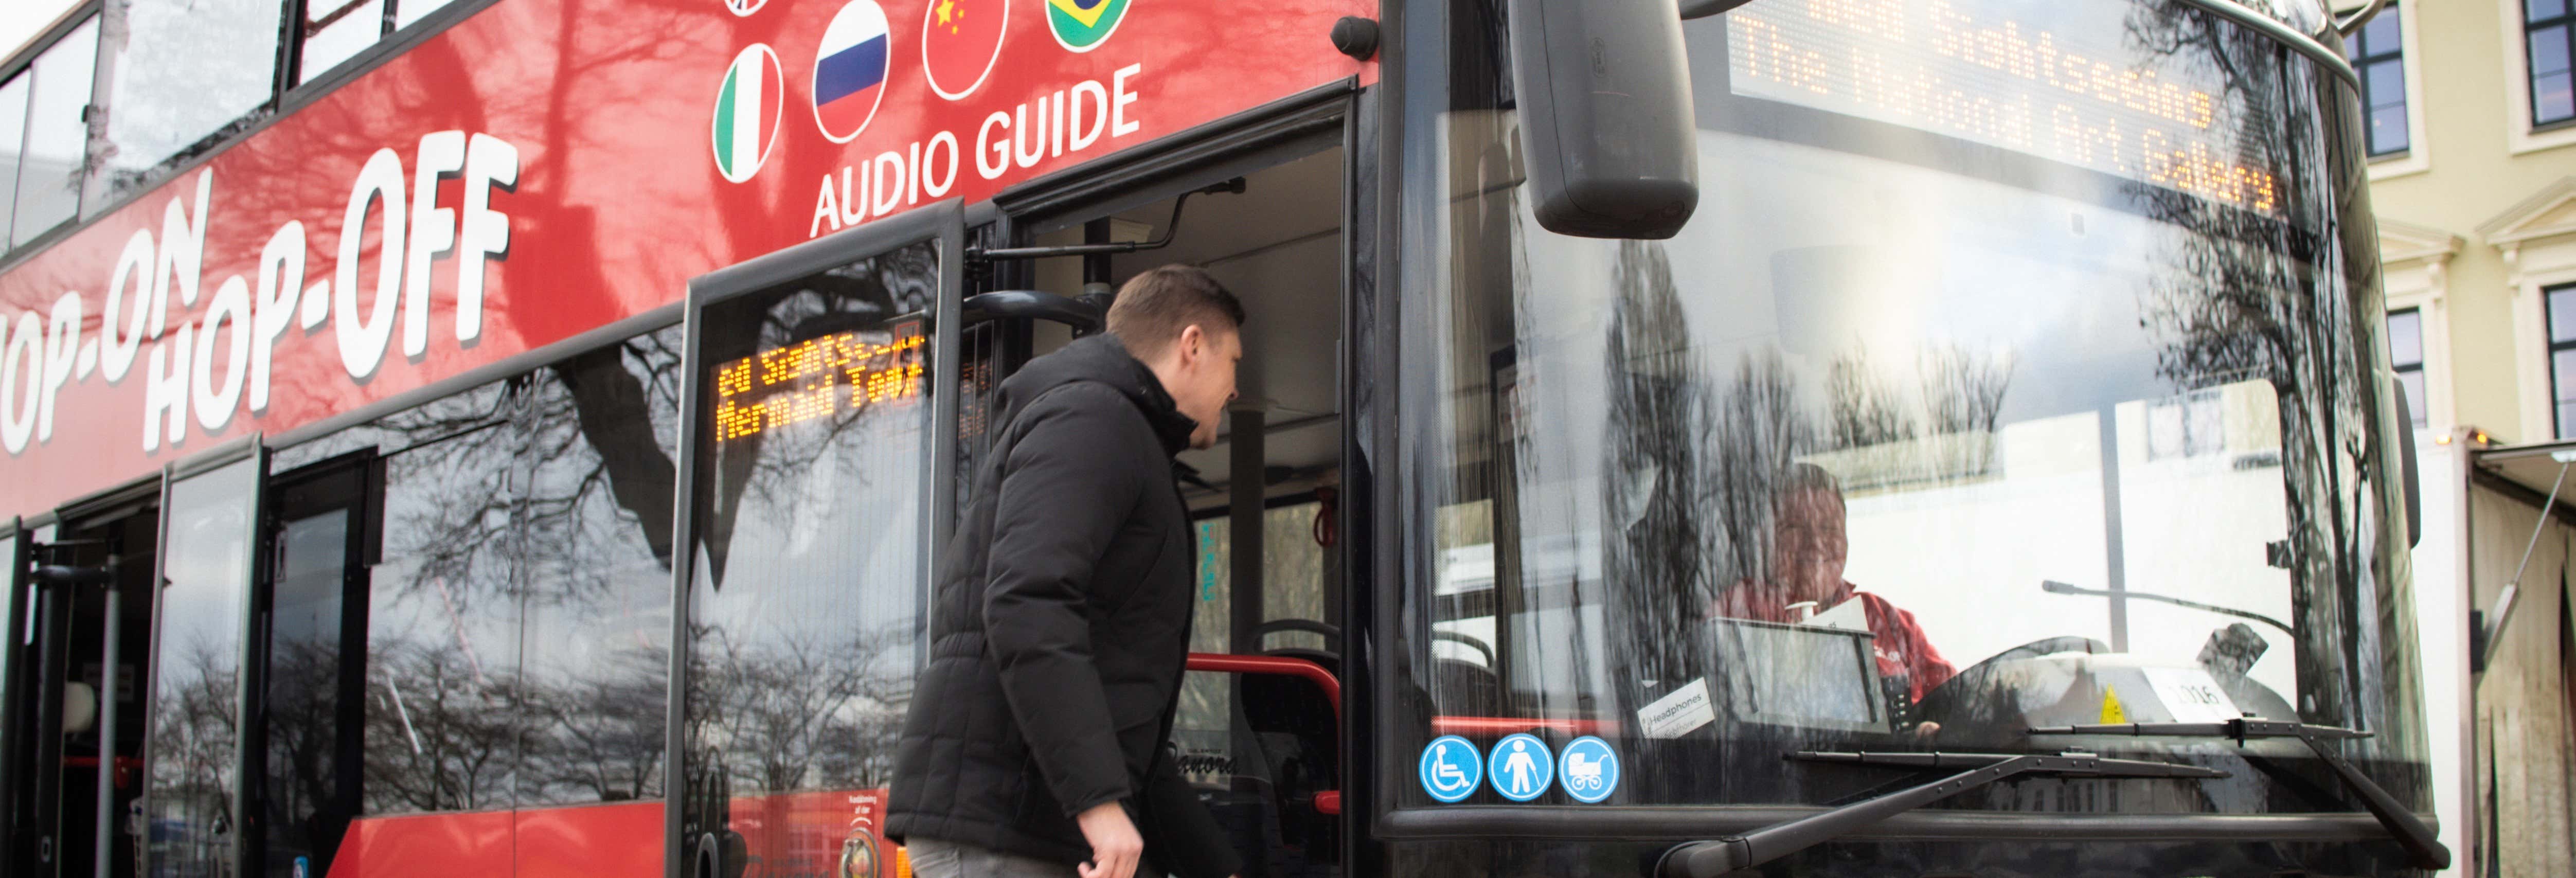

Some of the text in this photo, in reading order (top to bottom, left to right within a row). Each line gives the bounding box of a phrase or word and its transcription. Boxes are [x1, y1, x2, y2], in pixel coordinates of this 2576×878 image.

[1734, 14, 2274, 211] The National Art Gallery
[1929, 0, 2211, 129] Sightseeing
[810, 63, 1141, 239] AUDIO GUIDE
[0, 167, 213, 455] OP-ON
[143, 130, 518, 453] HOP-OFF
[716, 373, 834, 442] Mermaid
[718, 357, 752, 398] ed
[1649, 693, 1702, 725] Headphones
